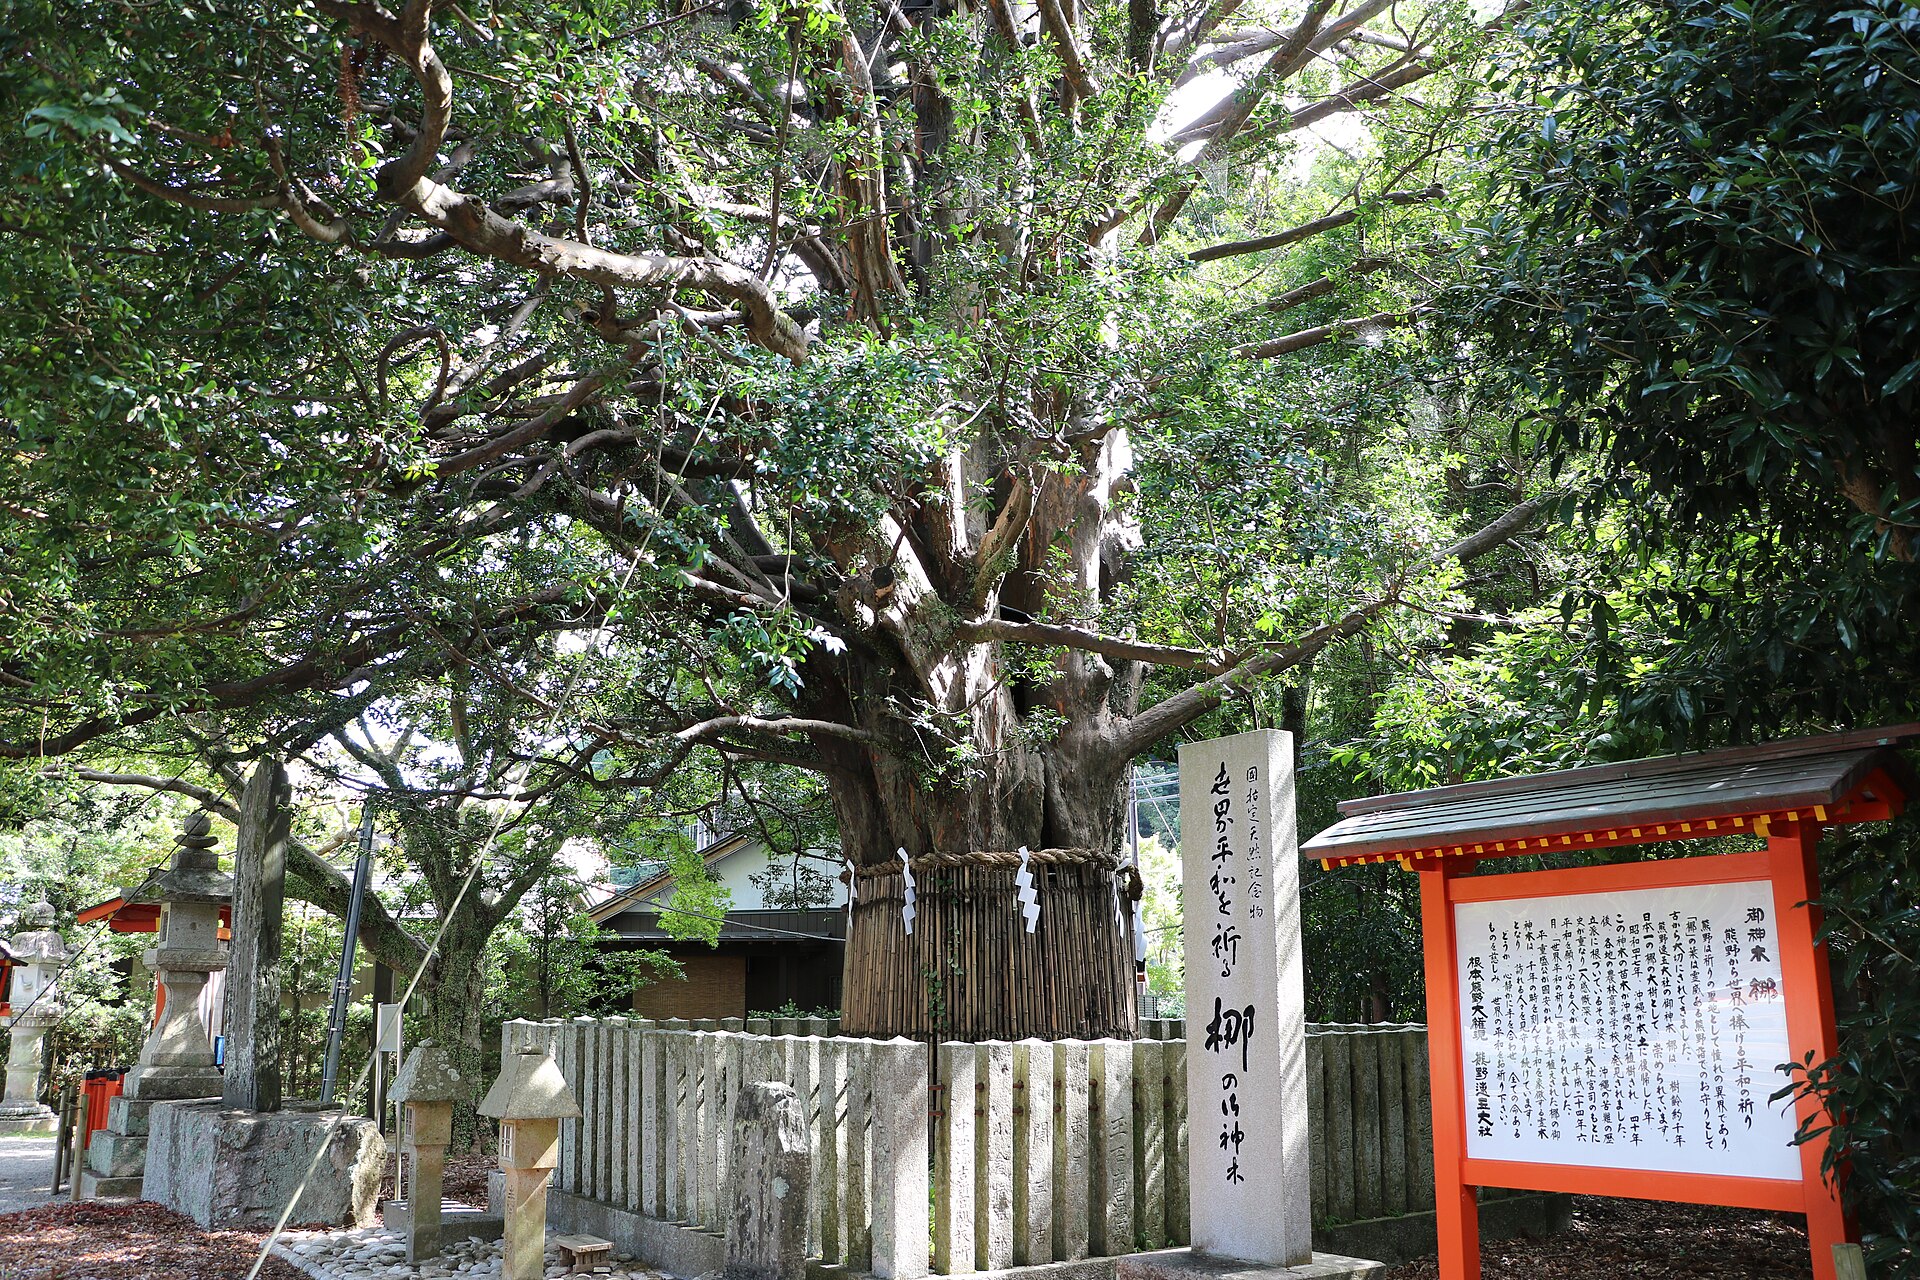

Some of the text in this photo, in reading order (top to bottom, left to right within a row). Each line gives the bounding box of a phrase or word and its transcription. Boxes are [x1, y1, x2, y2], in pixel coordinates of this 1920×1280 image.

[1744, 907, 1770, 962] 御神木
[1724, 928, 1754, 1131] 熊野から世界へ捧げる平和の祈り
